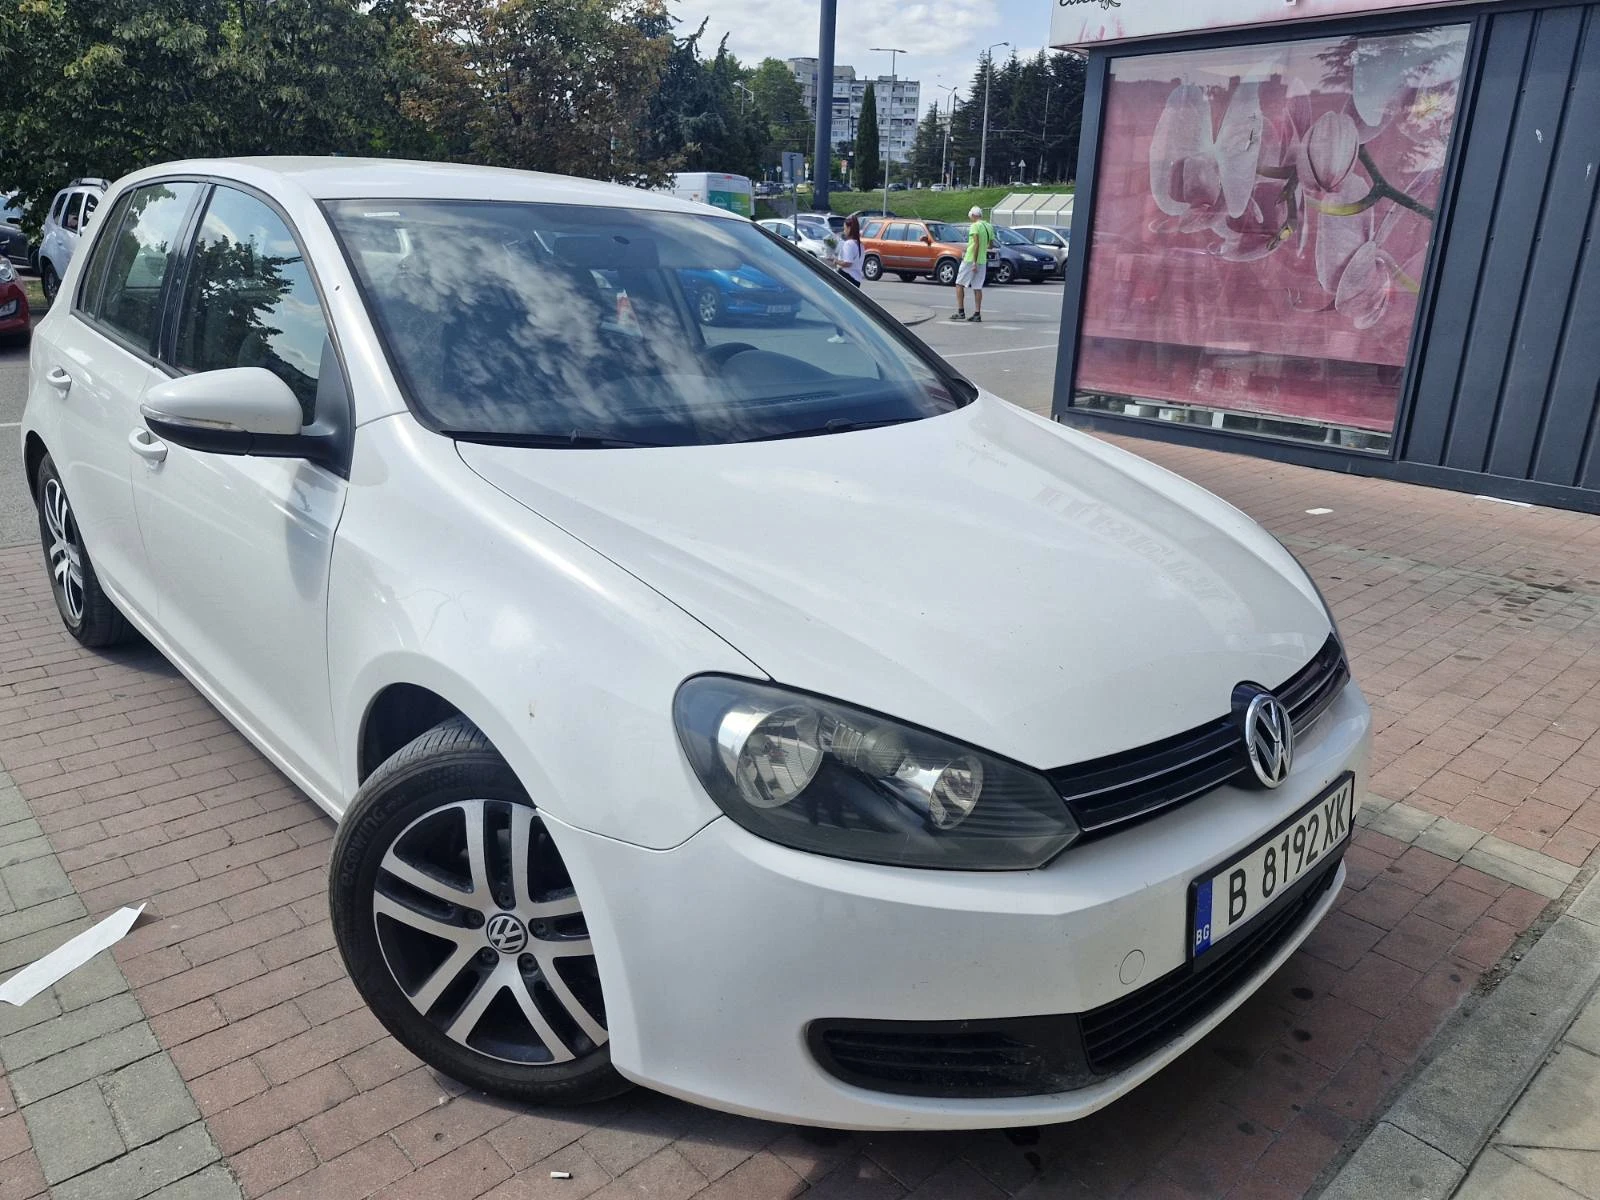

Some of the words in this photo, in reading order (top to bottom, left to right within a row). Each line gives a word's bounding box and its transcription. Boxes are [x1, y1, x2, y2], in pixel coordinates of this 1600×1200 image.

[1228, 868, 1247, 925] B
[1262, 814, 1320, 899] 8192
[1322, 787, 1348, 851] XK
[1196, 924, 1210, 945] BG
